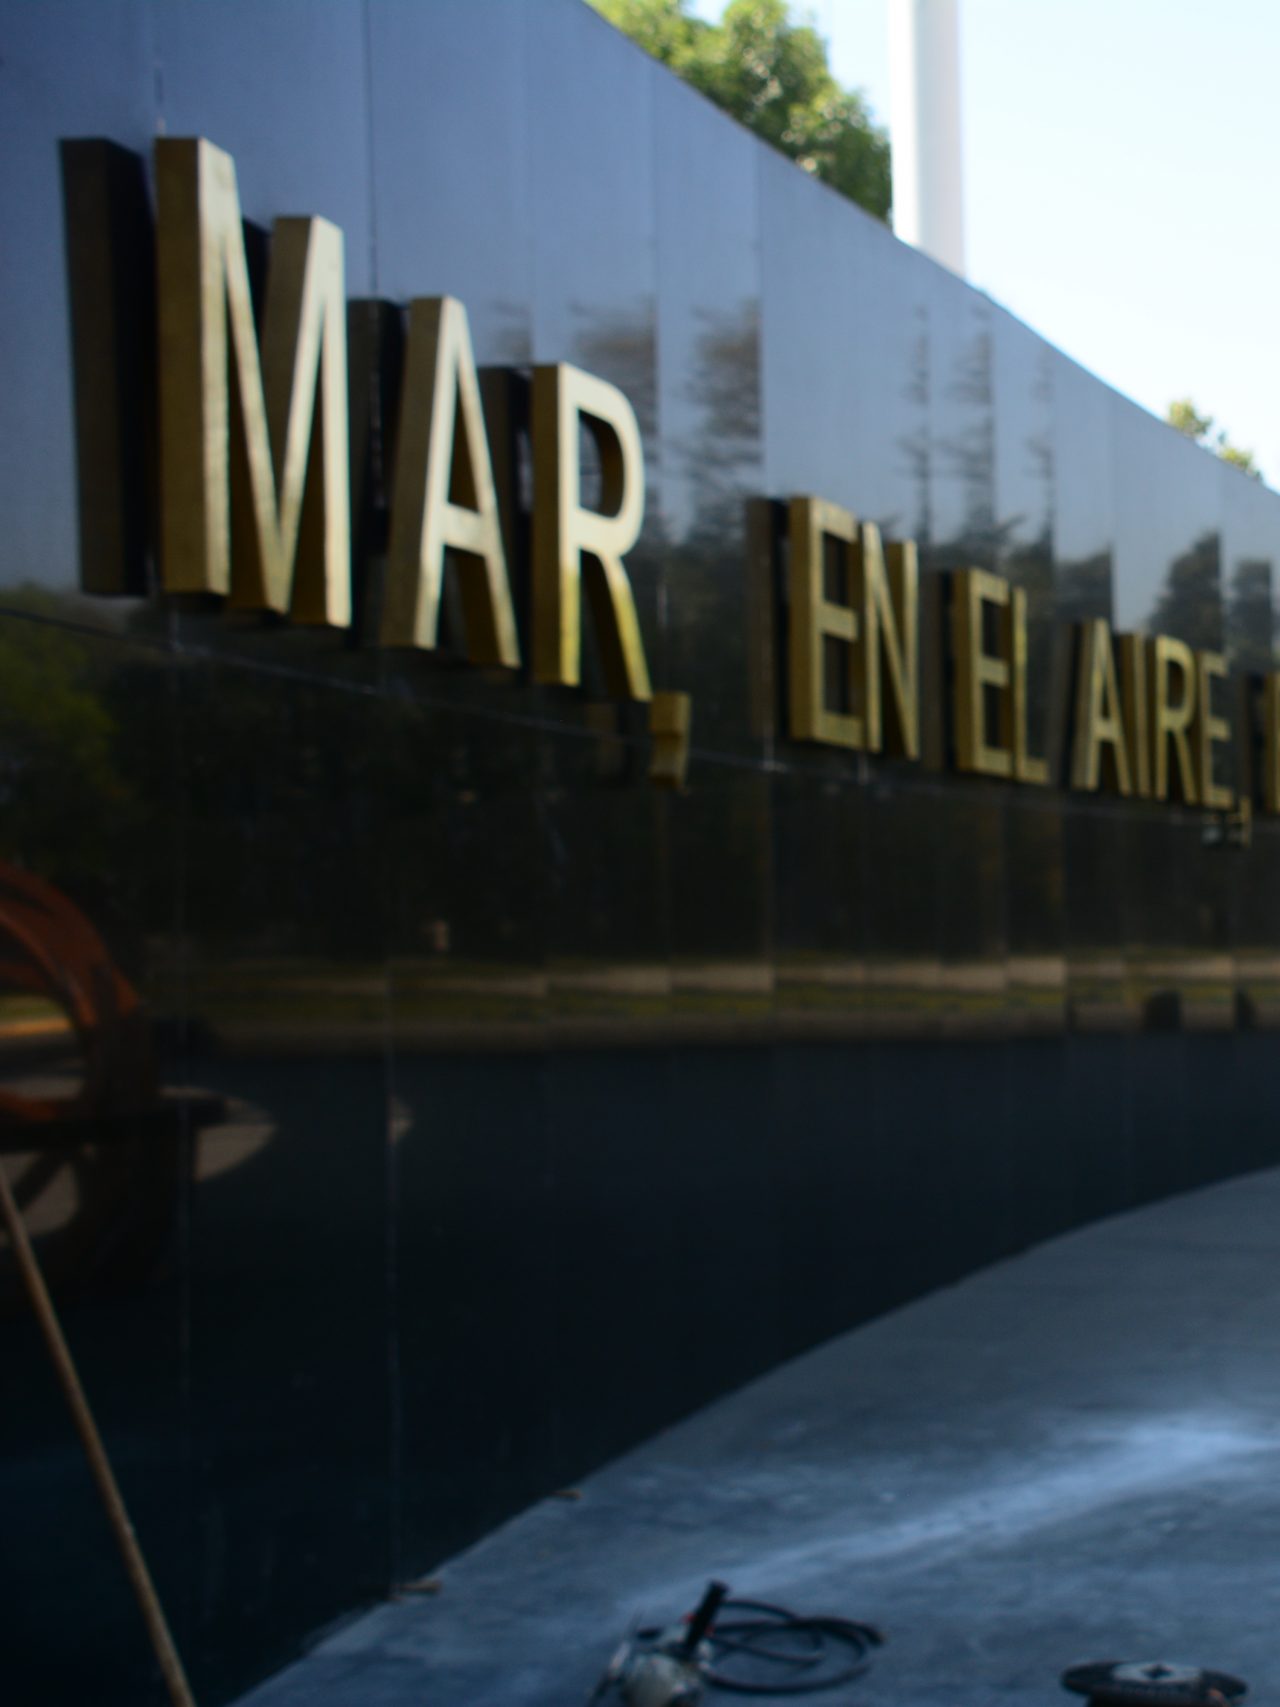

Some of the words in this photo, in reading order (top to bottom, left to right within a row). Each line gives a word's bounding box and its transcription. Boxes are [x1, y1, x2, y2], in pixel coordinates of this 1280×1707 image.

[155, 136, 690, 790] MAR,
[792, 495, 919, 762] EN
[954, 566, 1051, 786] EL
[1076, 616, 1253, 848] AIRE,
